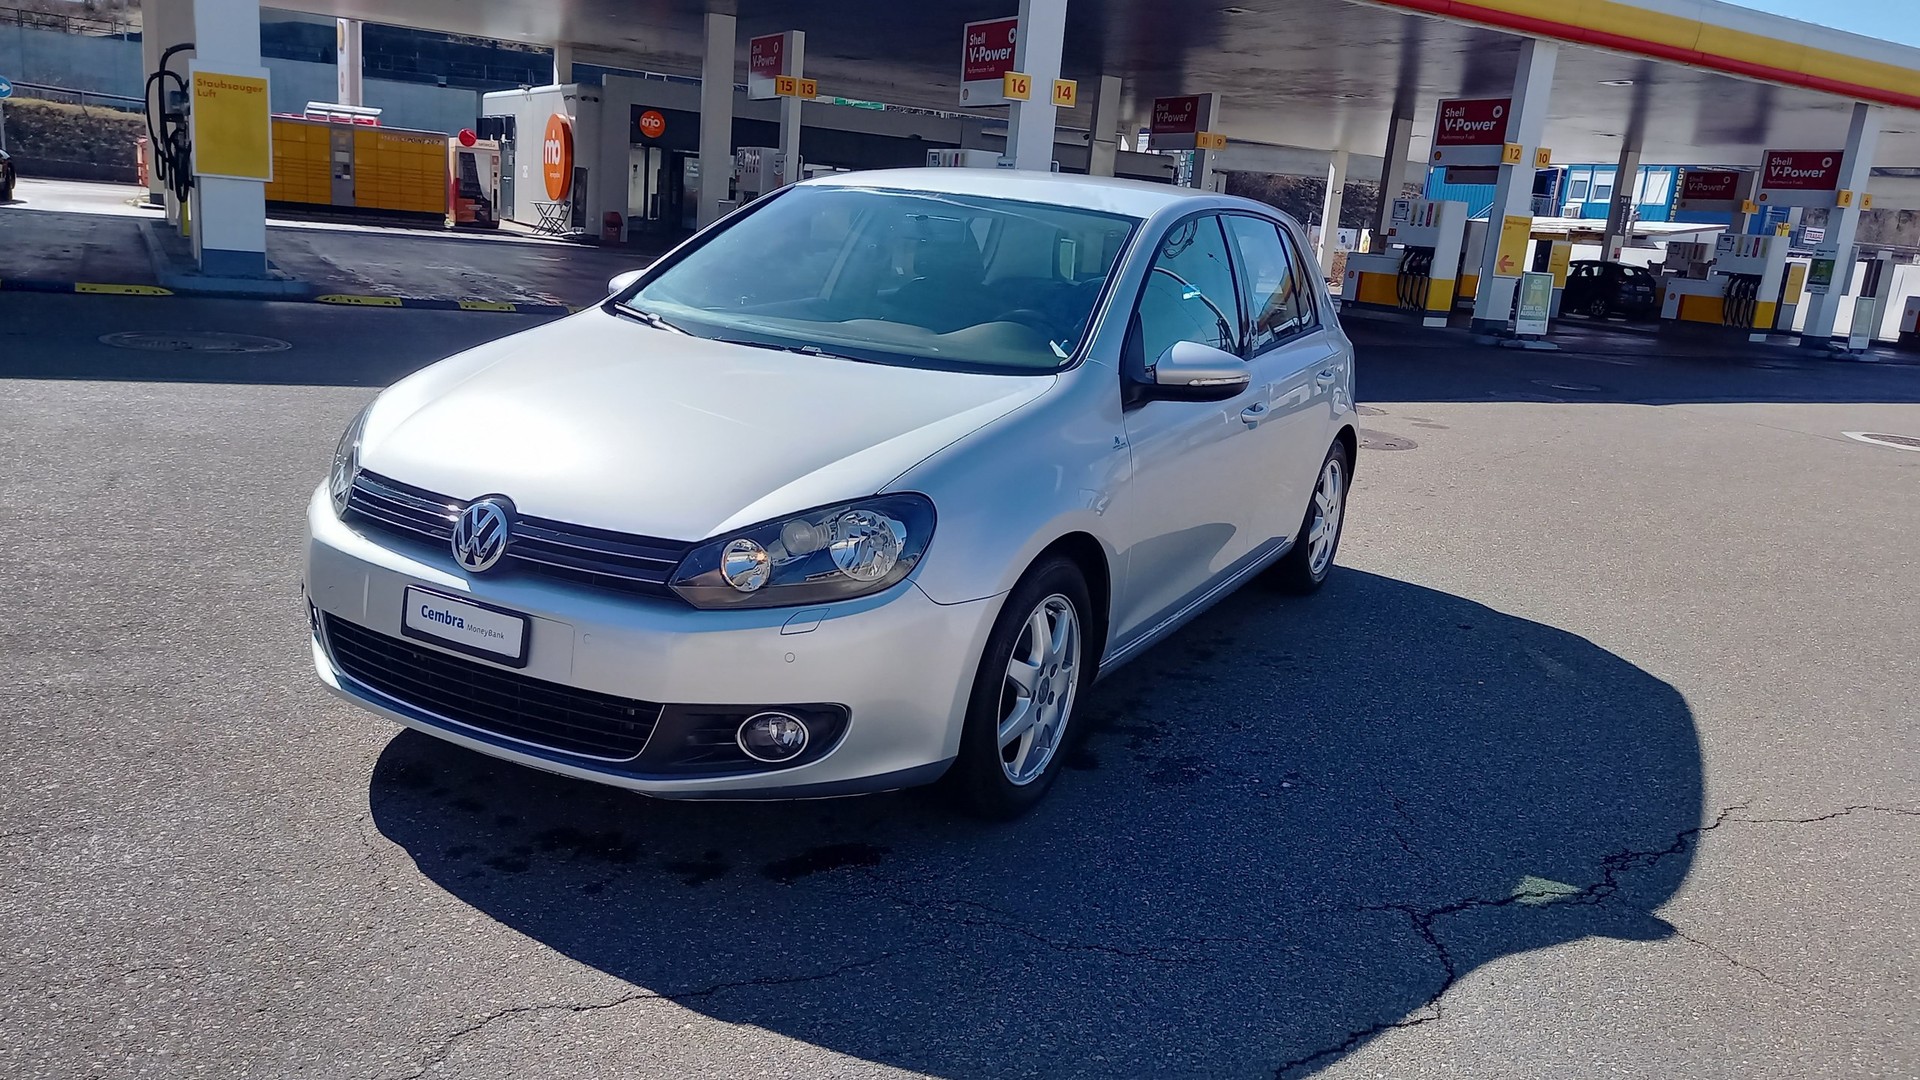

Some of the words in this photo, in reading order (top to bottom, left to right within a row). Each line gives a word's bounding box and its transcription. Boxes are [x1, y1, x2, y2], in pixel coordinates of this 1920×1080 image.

[969, 32, 986, 46] Shell
[969, 46, 1012, 63] V-Power
[196, 78, 263, 94] Staubsauger
[780, 80, 793, 92] 15
[801, 83, 814, 95] 13
[1012, 78, 1026, 94] 16
[197, 89, 217, 98] Luft
[1056, 85, 1072, 100] 14
[1156, 112, 1188, 123] V-Power
[1444, 107, 1465, 118] Shell
[1444, 118, 1497, 131] V-Power
[1509, 148, 1521, 160] 12
[1539, 153, 1548, 164] 10
[1771, 157, 1793, 166] Shell
[1770, 166, 1825, 178] V-Power
[1688, 183, 1726, 191] V-Power
[1668, 167, 1685, 222] CONTAINEX
[1844, 194, 1850, 203] 8
[455, 504, 505, 569] VW
[421, 604, 465, 629] Cembra
[466, 624, 505, 640] MoneyBank
